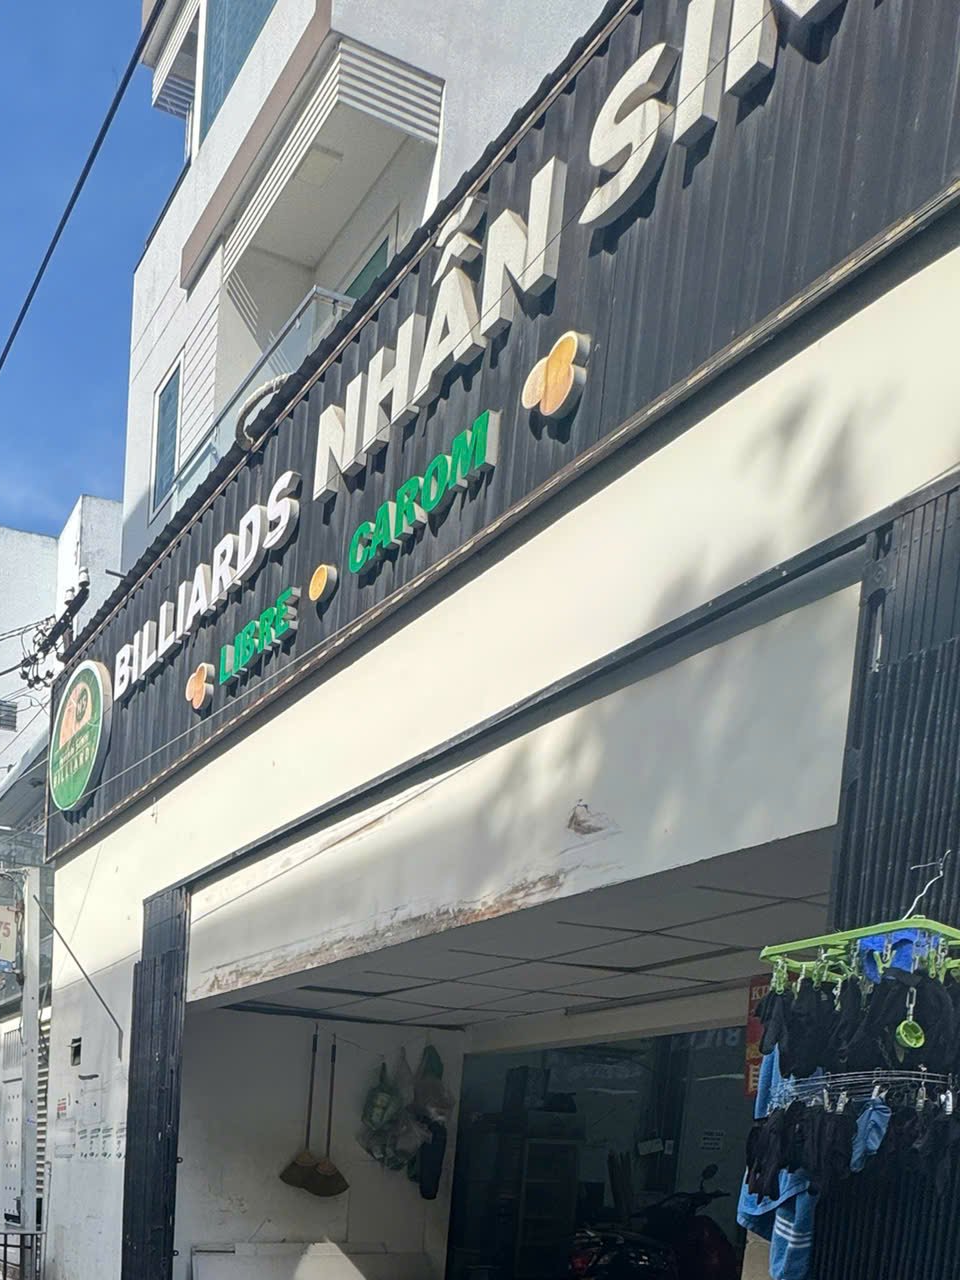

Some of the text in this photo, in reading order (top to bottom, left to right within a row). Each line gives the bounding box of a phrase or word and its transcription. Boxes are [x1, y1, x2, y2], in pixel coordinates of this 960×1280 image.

[114, 470, 300, 701] BILLIARDS
[219, 409, 498, 685] LIBRE CAROM
